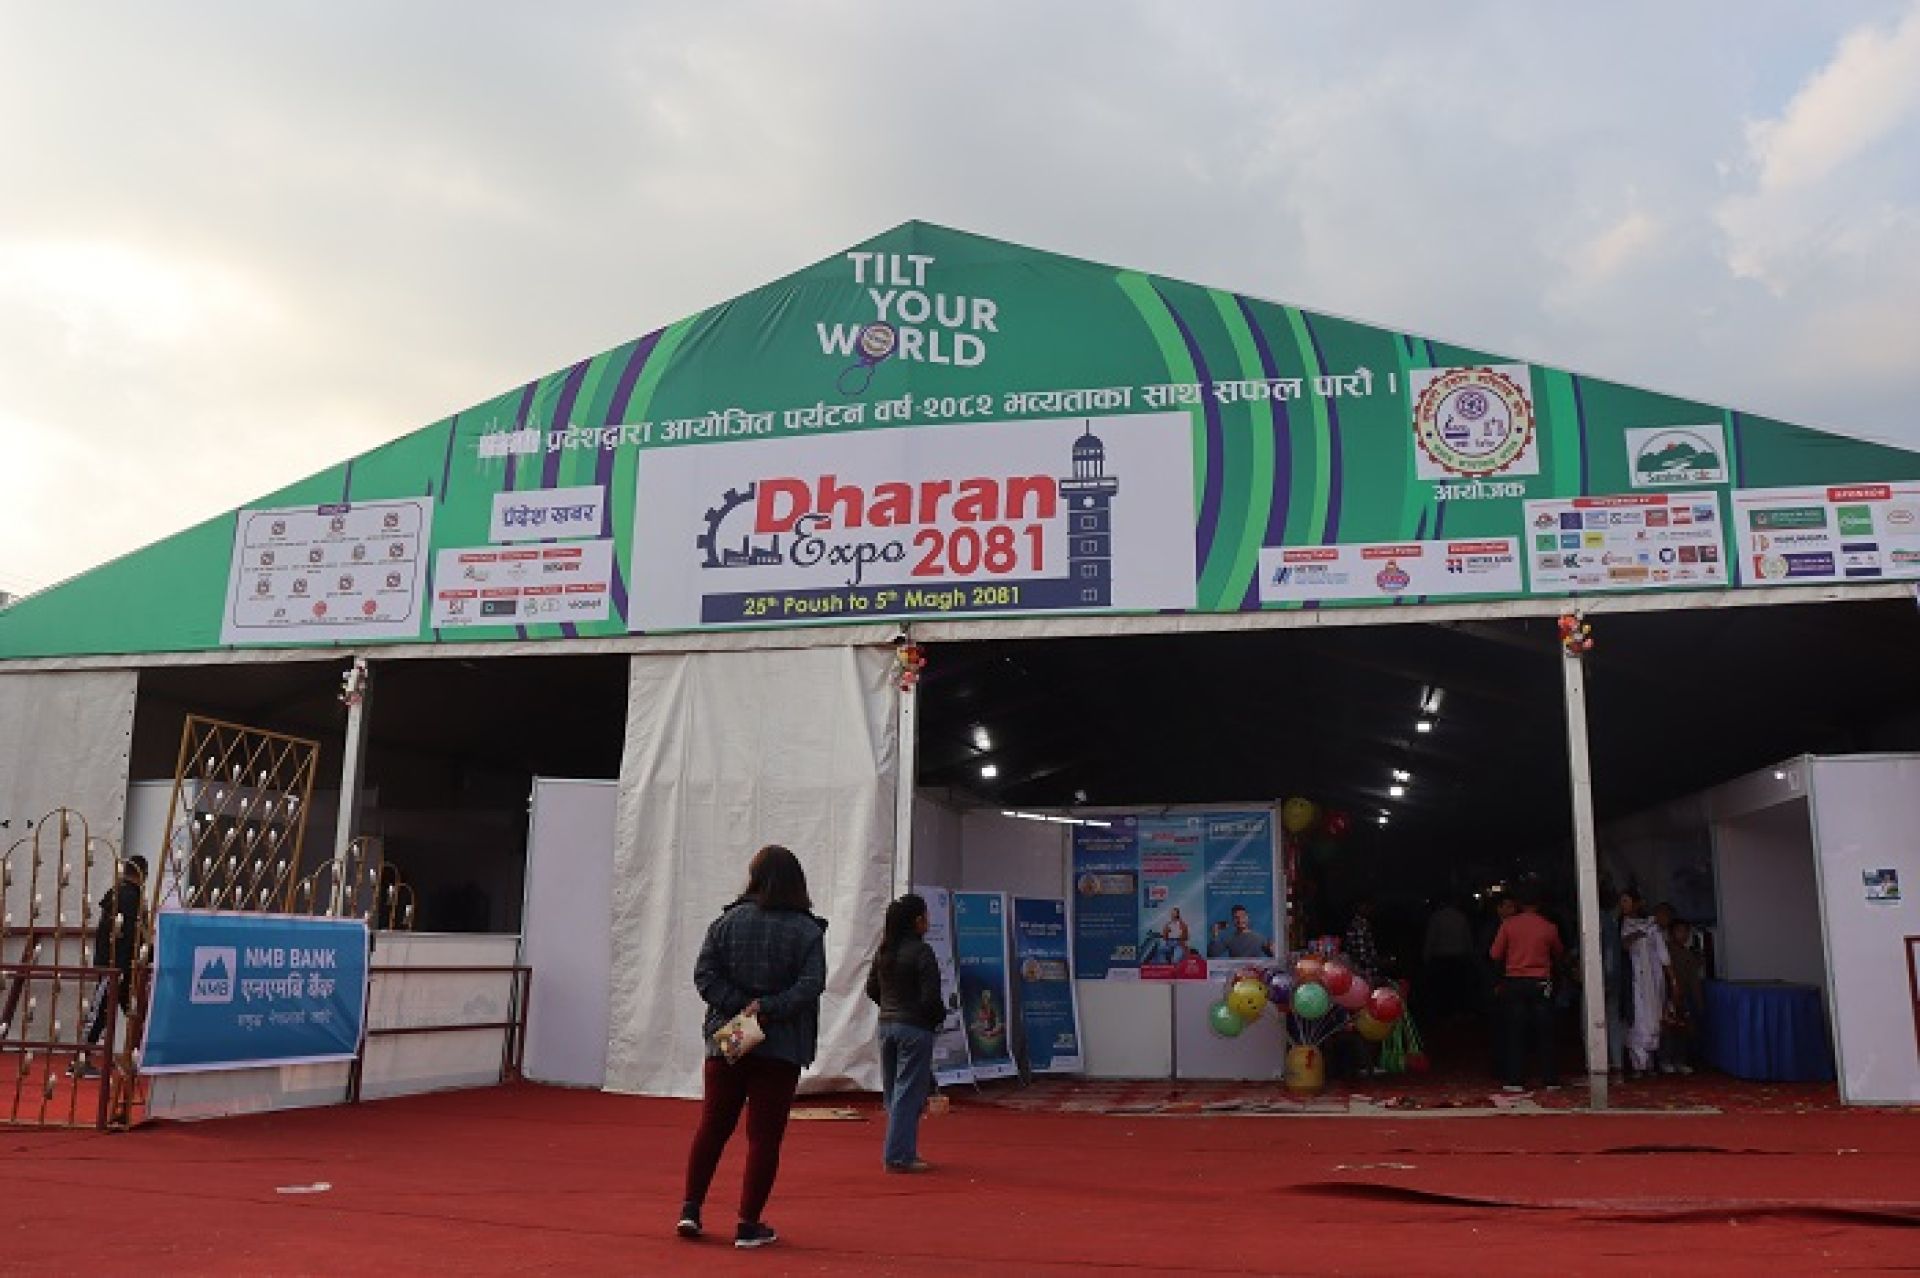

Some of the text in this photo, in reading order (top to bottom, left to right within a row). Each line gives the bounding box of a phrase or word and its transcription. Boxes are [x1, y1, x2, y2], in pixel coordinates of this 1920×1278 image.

[847, 252, 936, 287] TILT
[868, 288, 999, 333] YOUR
[817, 322, 986, 367] WORLD
[660, 409, 774, 442] आयोजित
[783, 400, 867, 430] पर्यटन
[1003, 386, 1133, 415] भव्यताका
[1141, 380, 1203, 408] साथ
[1212, 378, 1303, 404] सफल
[753, 474, 1057, 534] Dharan
[1432, 480, 1526, 501] आयोजक
[551, 504, 596, 524] खबर
[789, 514, 1047, 587] Expo 2081
[784, 594, 843, 614] Paush
[849, 592, 868, 611] to
[905, 588, 966, 612] Magh
[972, 586, 1019, 606] 2081
[244, 948, 337, 968] NMB BANK
